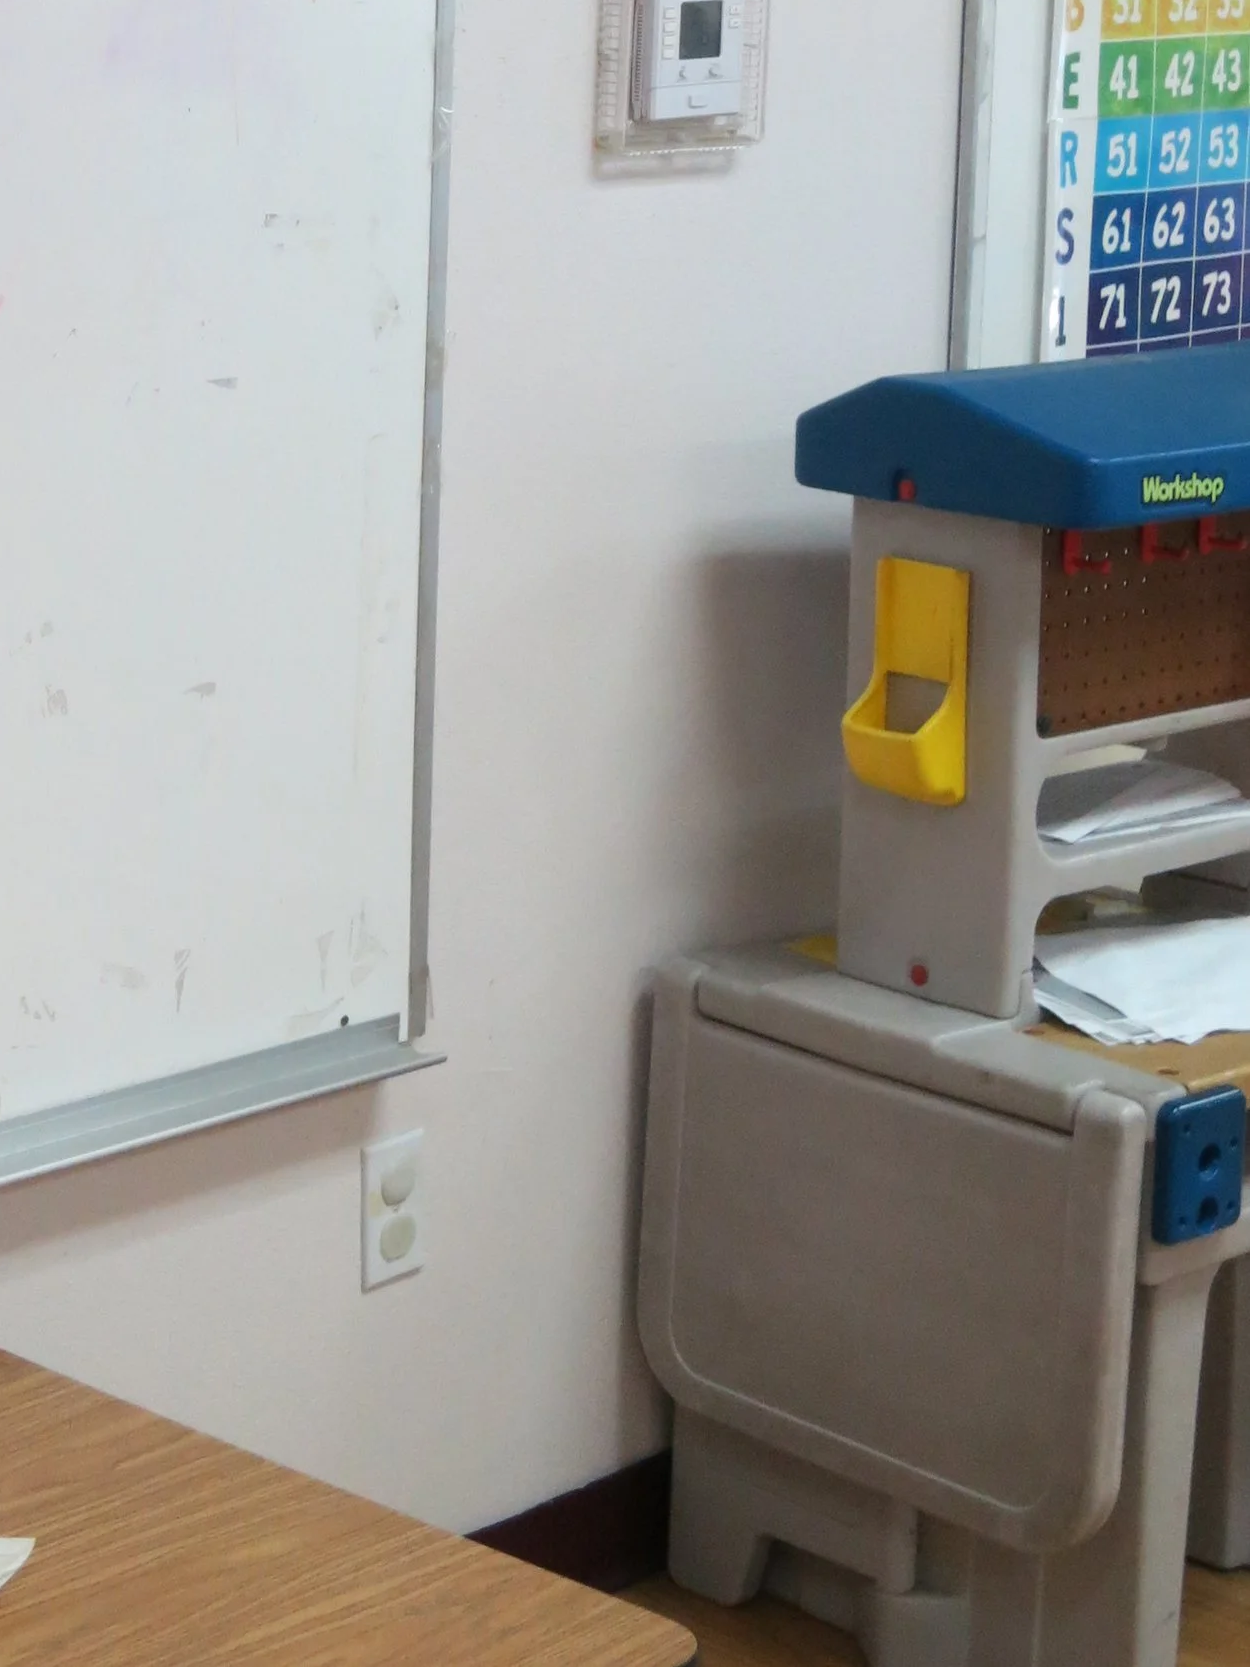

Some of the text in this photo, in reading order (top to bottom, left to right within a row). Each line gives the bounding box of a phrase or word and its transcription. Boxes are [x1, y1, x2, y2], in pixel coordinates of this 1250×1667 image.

[1109, 48, 1241, 100] 41 42 43
[1107, 124, 1239, 178] 51 52 53
[1102, 196, 1236, 254] 61 62 63
[1099, 270, 1232, 330] 71 72 73
[1142, 473, 1225, 504] Workshop
